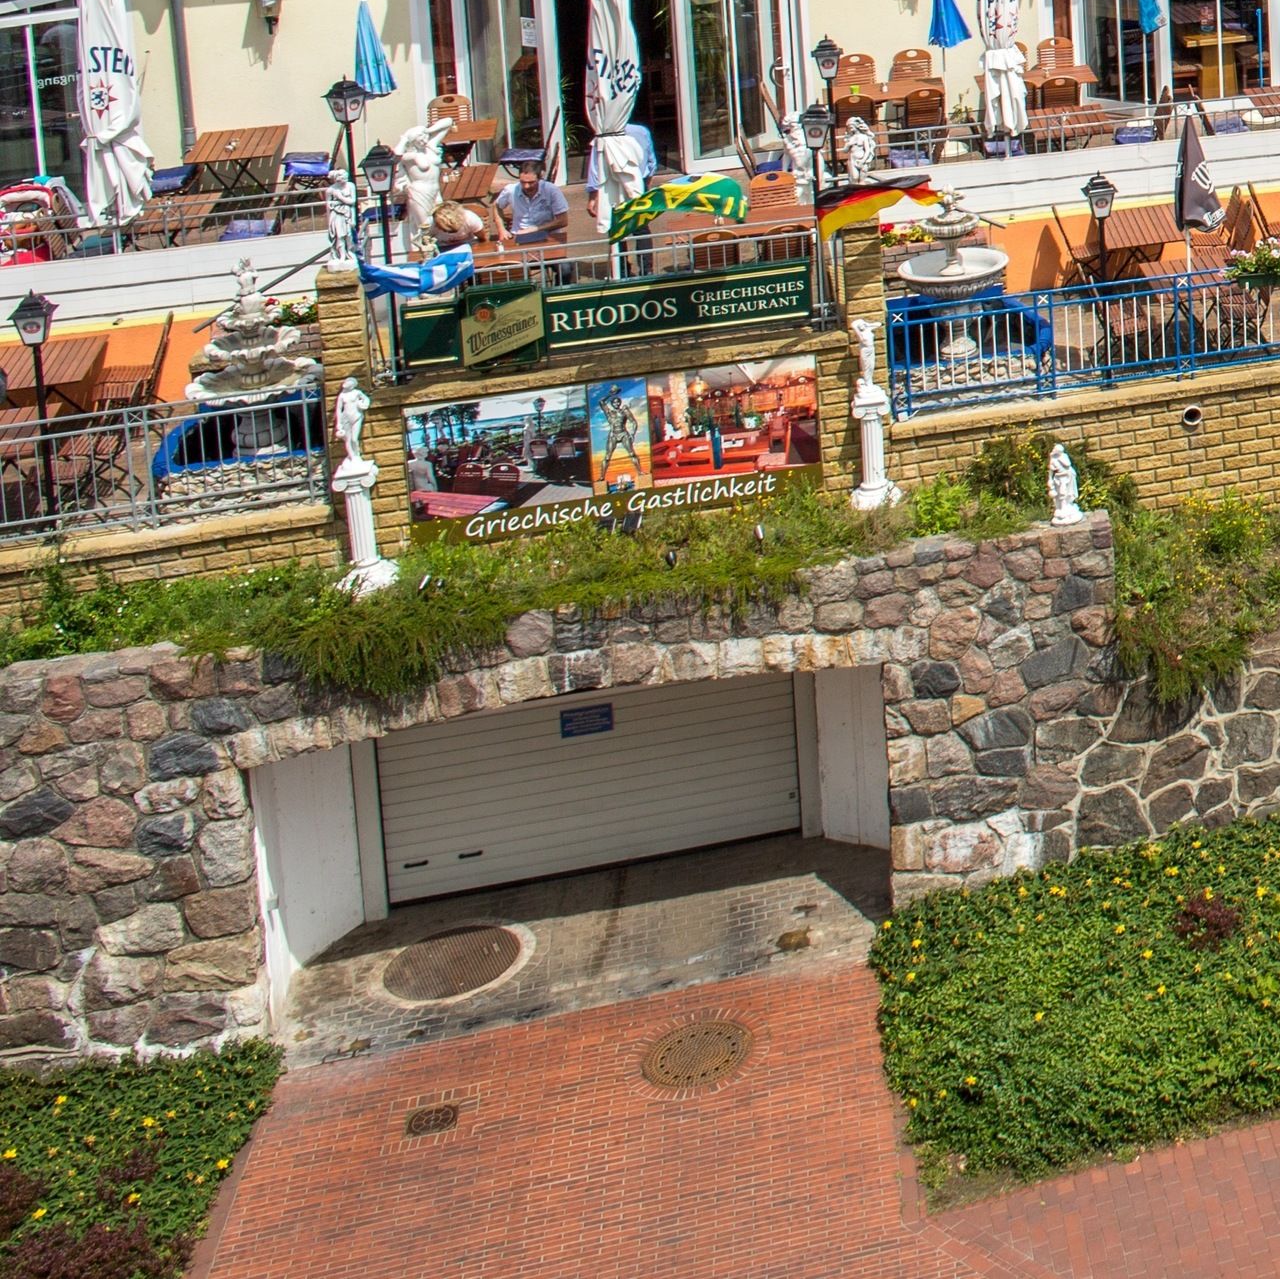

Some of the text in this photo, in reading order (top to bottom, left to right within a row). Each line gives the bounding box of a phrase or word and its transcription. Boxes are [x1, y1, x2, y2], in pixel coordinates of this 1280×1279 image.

[550, 279, 805, 333] RHODOS GRIECHISCHES
[697, 294, 800, 318] RESTAURANT
[464, 472, 778, 538] Griechische Gastlichkeit
